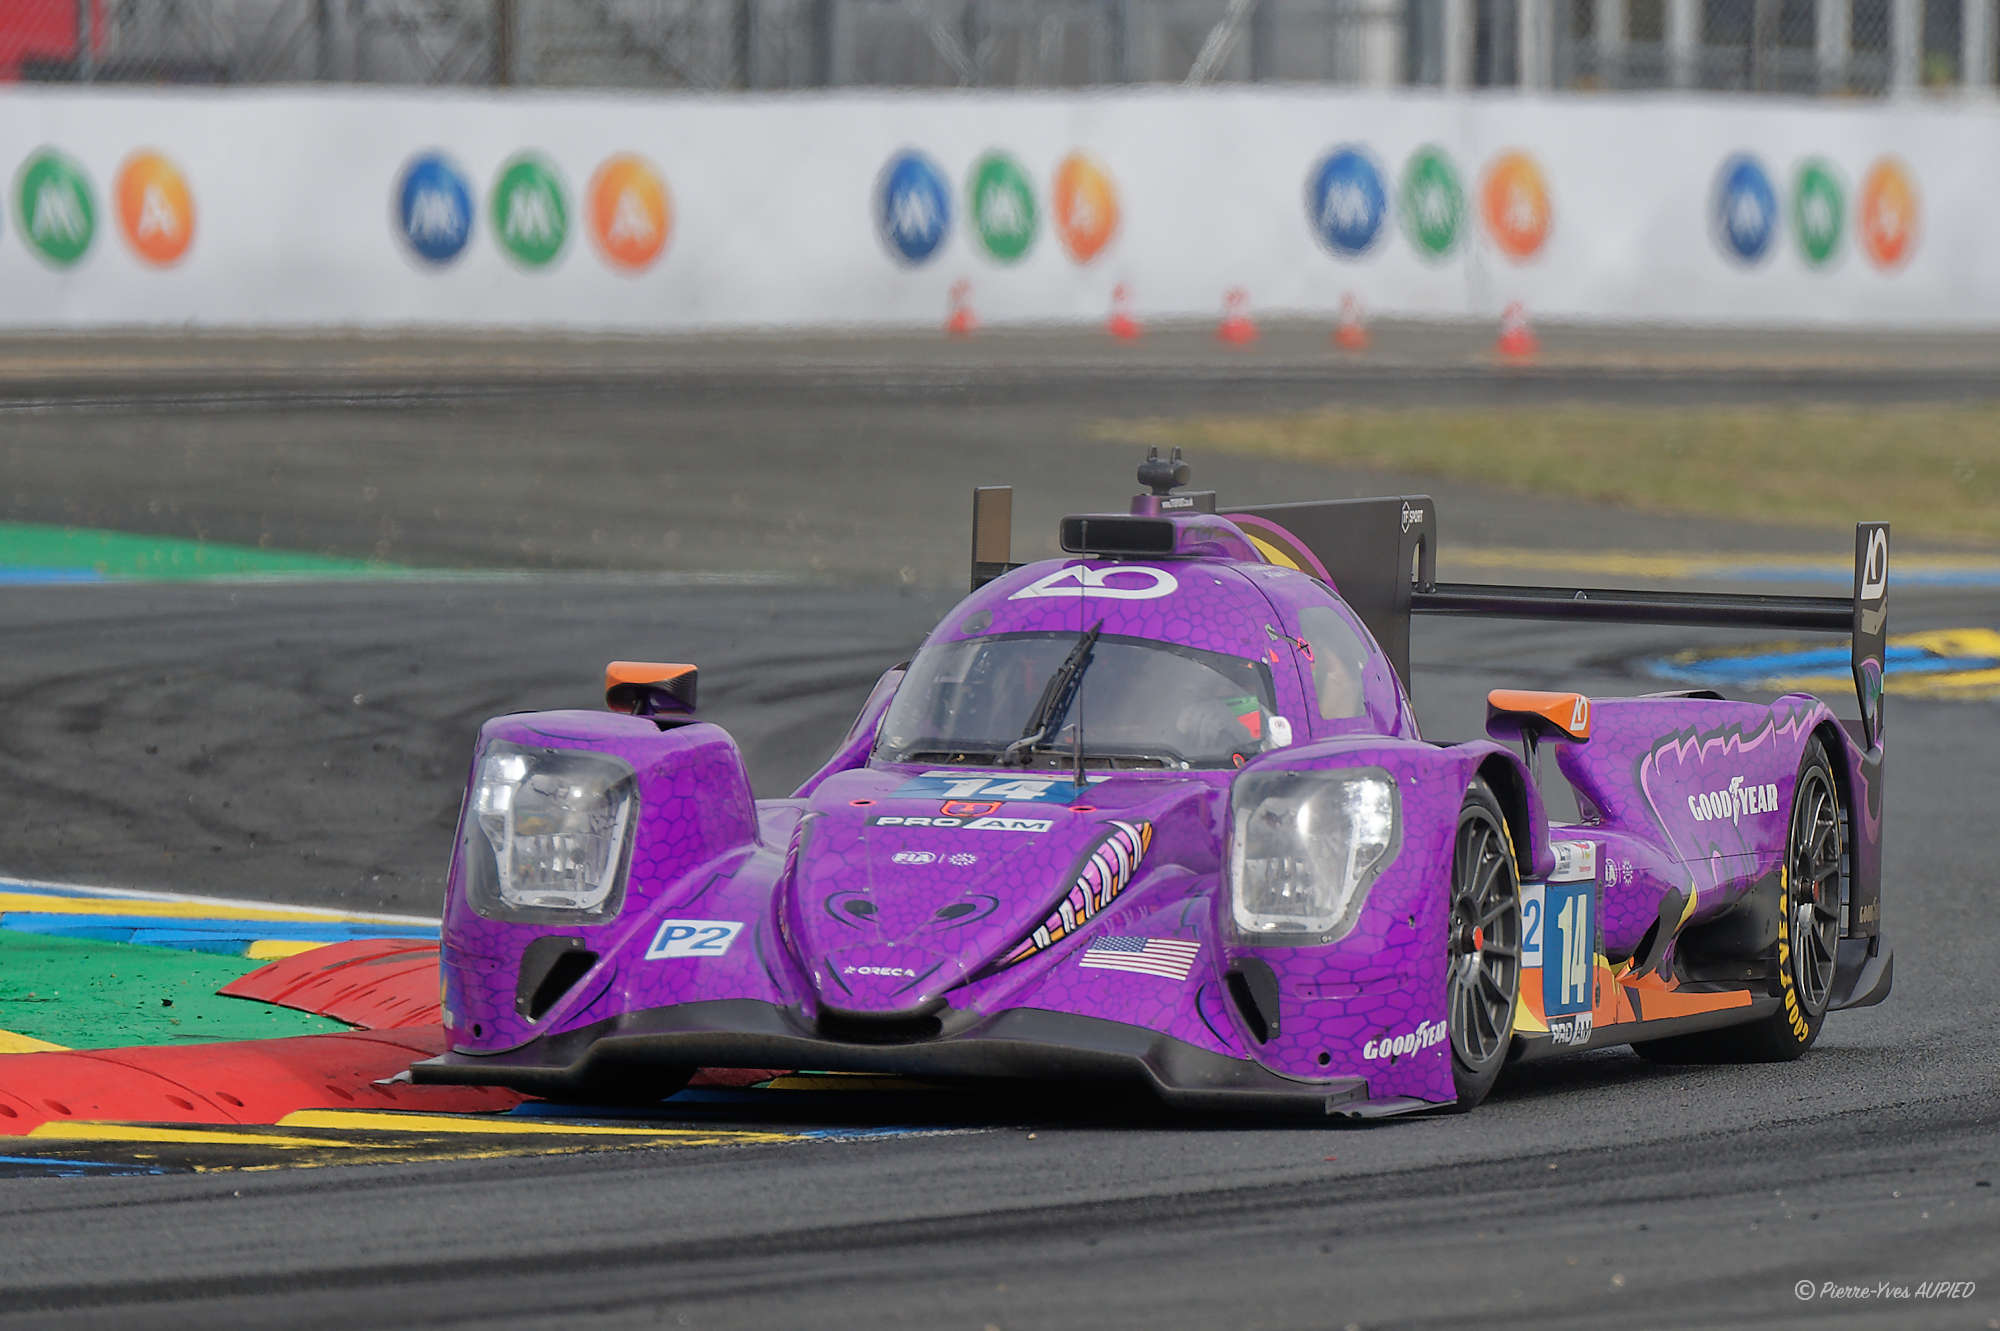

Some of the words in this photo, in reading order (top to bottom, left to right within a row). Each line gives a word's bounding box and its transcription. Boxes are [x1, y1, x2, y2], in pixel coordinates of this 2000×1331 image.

[942, 778, 1056, 800] 14
[1688, 775, 1779, 827] GOODYEAR
[876, 816, 963, 827] PRO
[978, 820, 1046, 831] AM
[891, 851, 936, 865] FIA
[654, 926, 732, 952] P2
[1522, 899, 1542, 954] 2
[1558, 893, 1588, 1005] 14
[858, 966, 916, 977] ORECA
[1363, 1019, 1448, 1060] GOODYEAR
[1551, 1022, 1573, 1044] PRO
[1575, 1020, 1592, 1041] AM
